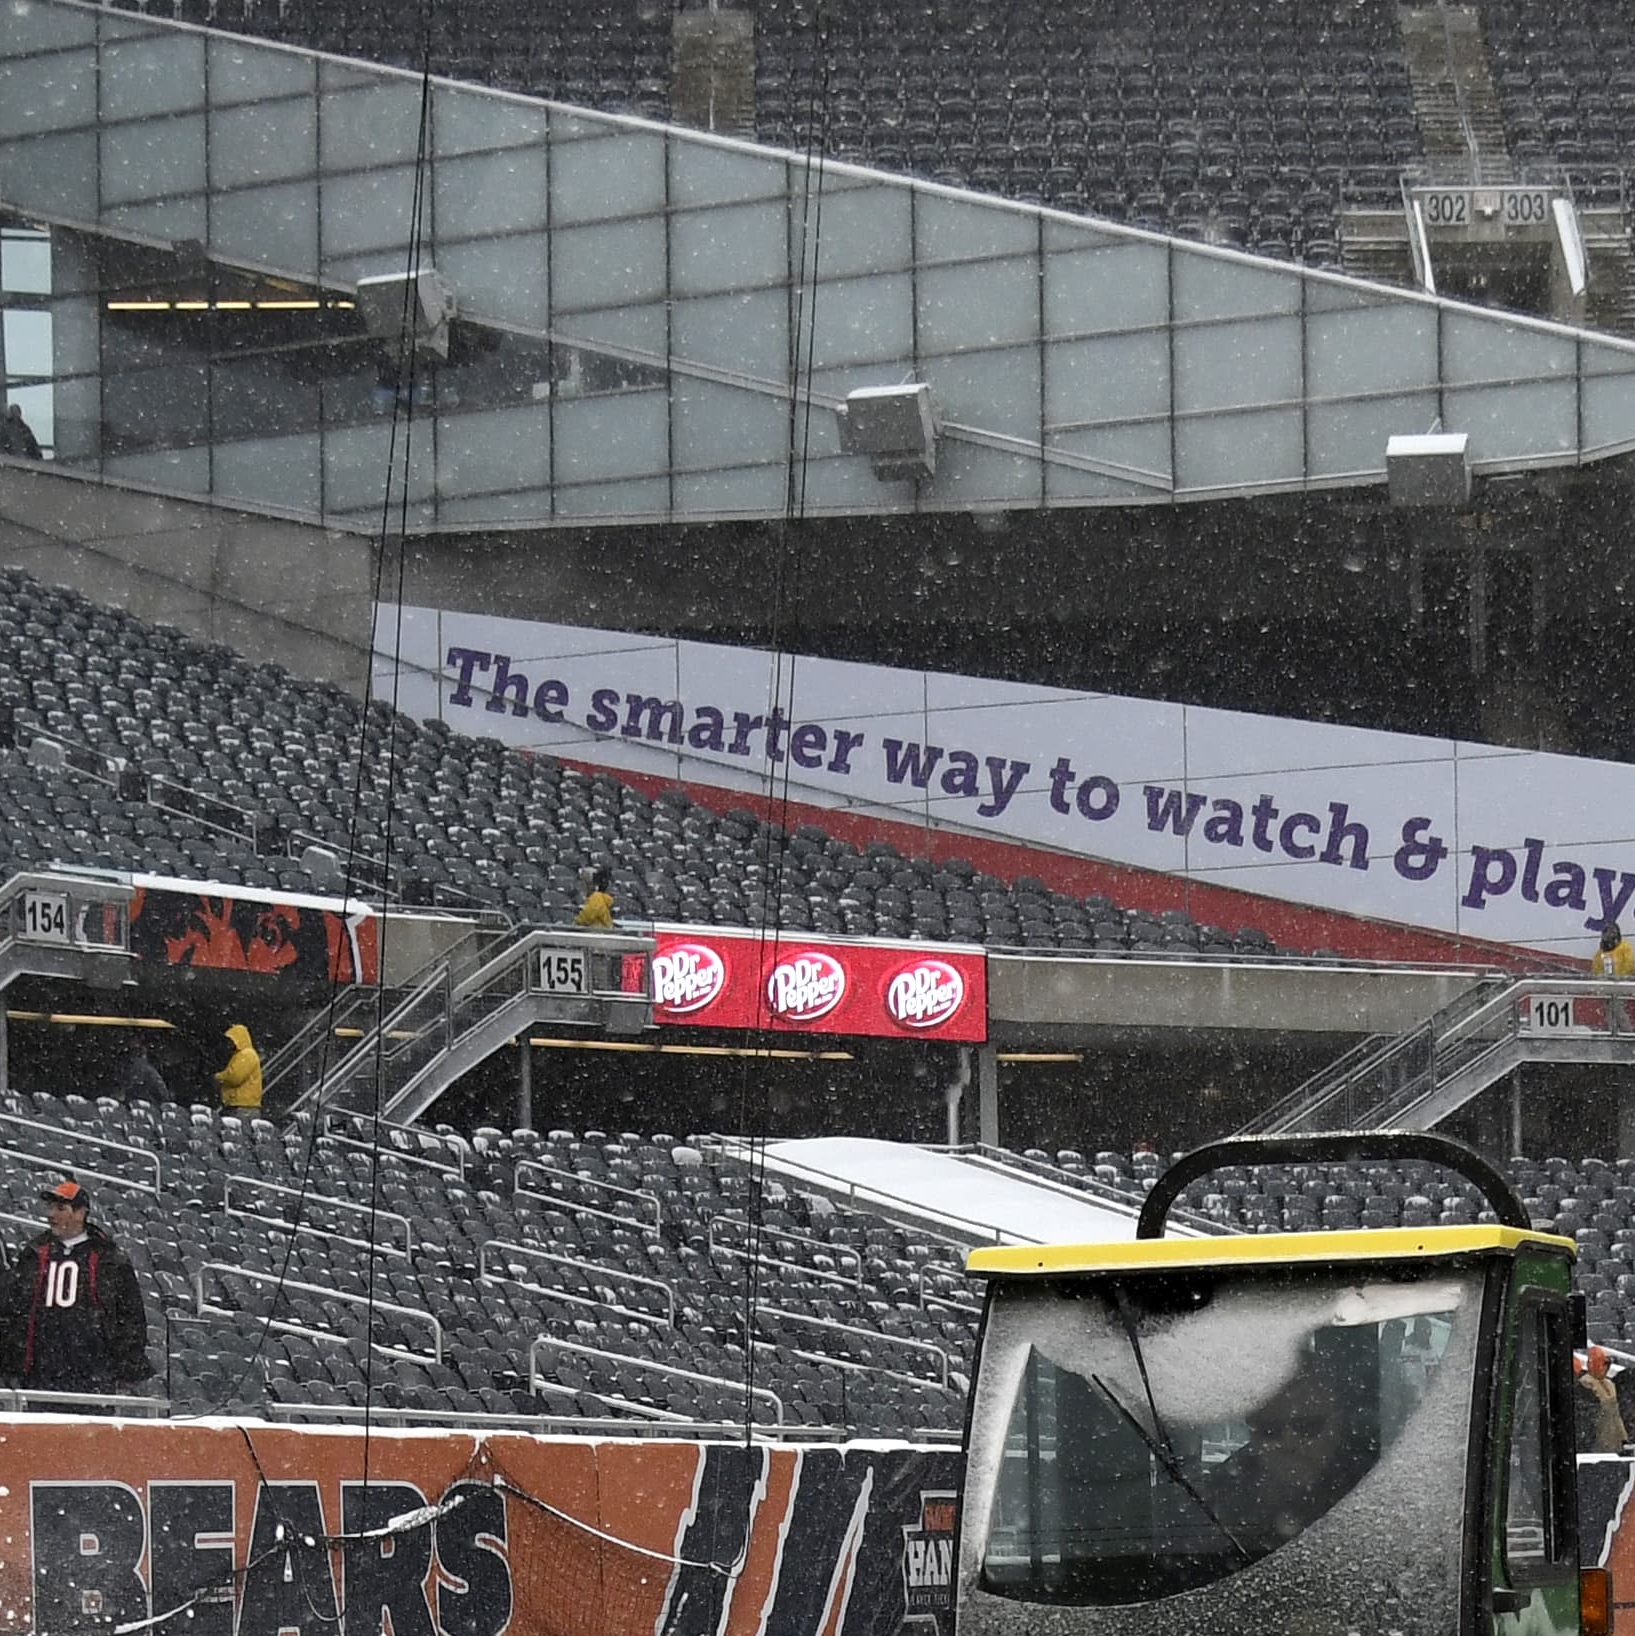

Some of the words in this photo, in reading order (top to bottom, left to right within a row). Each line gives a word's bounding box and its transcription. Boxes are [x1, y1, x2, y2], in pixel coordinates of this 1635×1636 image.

[1428, 194, 1466, 222] 302
[1507, 194, 1545, 221] 303
[446, 646, 570, 724] The
[585, 687, 865, 776] smarter
[882, 737, 1031, 818] way
[1049, 757, 1121, 821] to
[1142, 783, 1369, 871] watch
[1394, 817, 1448, 881] &
[28, 901, 64, 934] 154
[543, 955, 583, 990] 155
[653, 958, 718, 1005] Pepper
[673, 950, 701, 978] Dr
[795, 959, 823, 990] Dr
[774, 964, 839, 1013] Pepper
[895, 972, 958, 1020] Pepper
[913, 967, 941, 998] Dr
[1535, 1002, 1570, 1028] 101
[45, 1260, 79, 1308] 10
[908, 1539, 953, 1588] HAN
